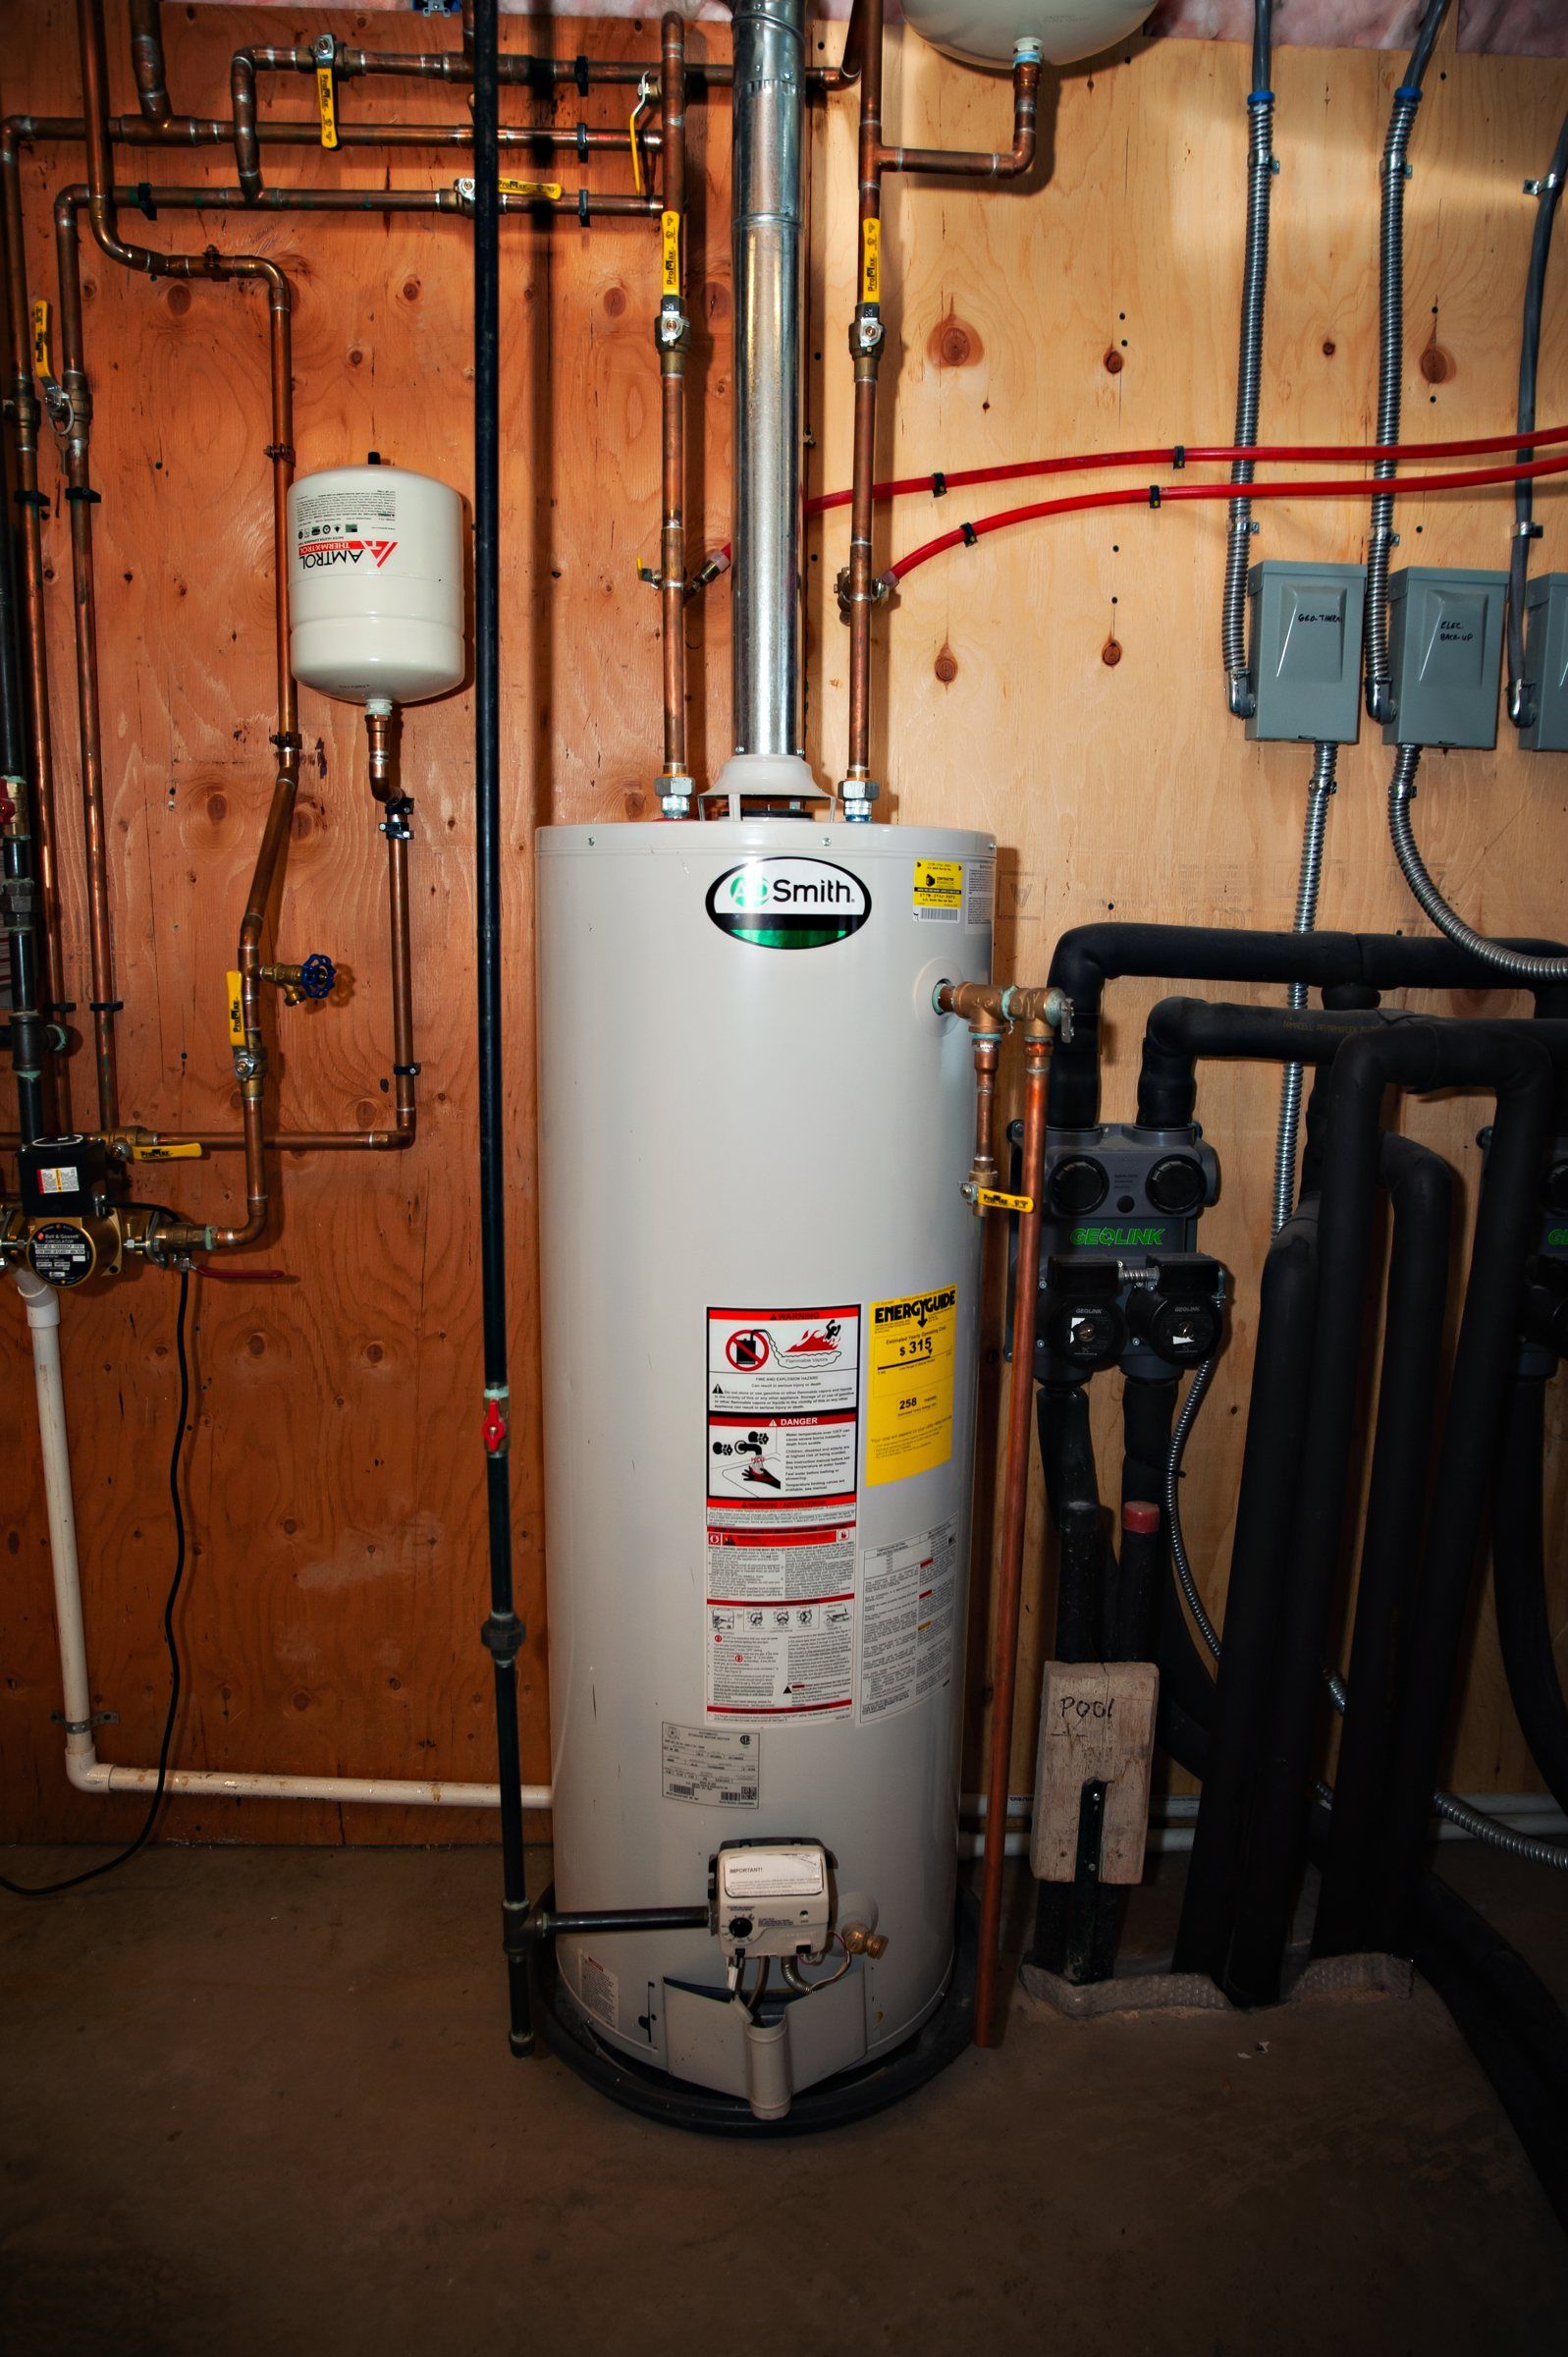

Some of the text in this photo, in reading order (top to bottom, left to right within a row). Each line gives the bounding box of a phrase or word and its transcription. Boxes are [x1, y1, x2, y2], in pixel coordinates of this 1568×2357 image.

[298, 550, 363, 570] AMTROL
[773, 879, 850, 903] Smith
[1070, 1227, 1165, 1245] GEOLINK
[909, 1337, 932, 1353] 315
[899, 1397, 917, 1410] 258
[781, 1417, 818, 1426] DANGER
